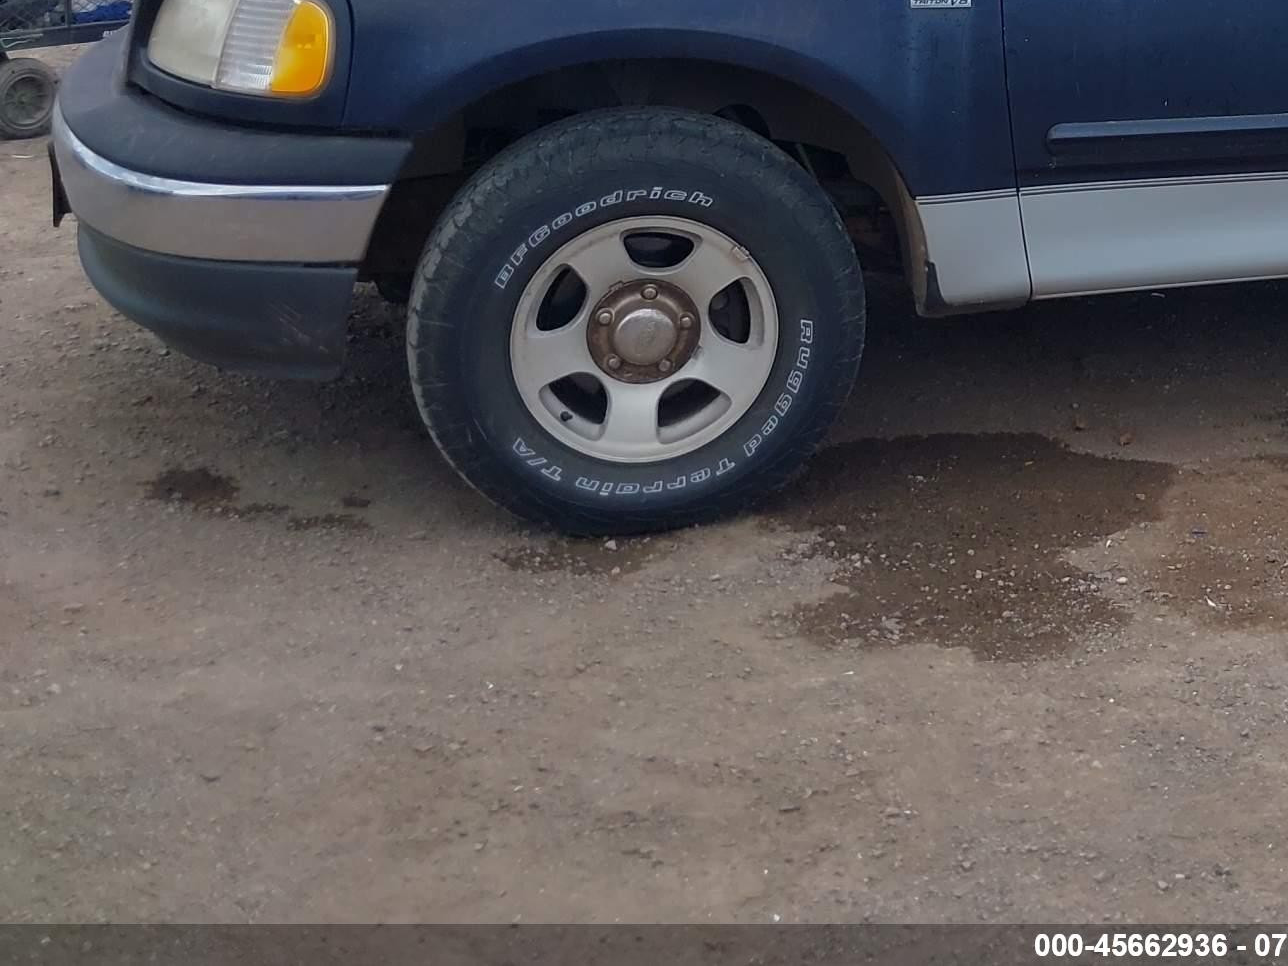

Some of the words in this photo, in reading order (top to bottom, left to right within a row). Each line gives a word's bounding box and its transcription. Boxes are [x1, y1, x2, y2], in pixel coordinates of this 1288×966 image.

[494, 186, 714, 289] BFGoodrich
[742, 319, 815, 458] Rugged
[512, 437, 563, 481] T/A
[574, 458, 735, 496] Terrain
